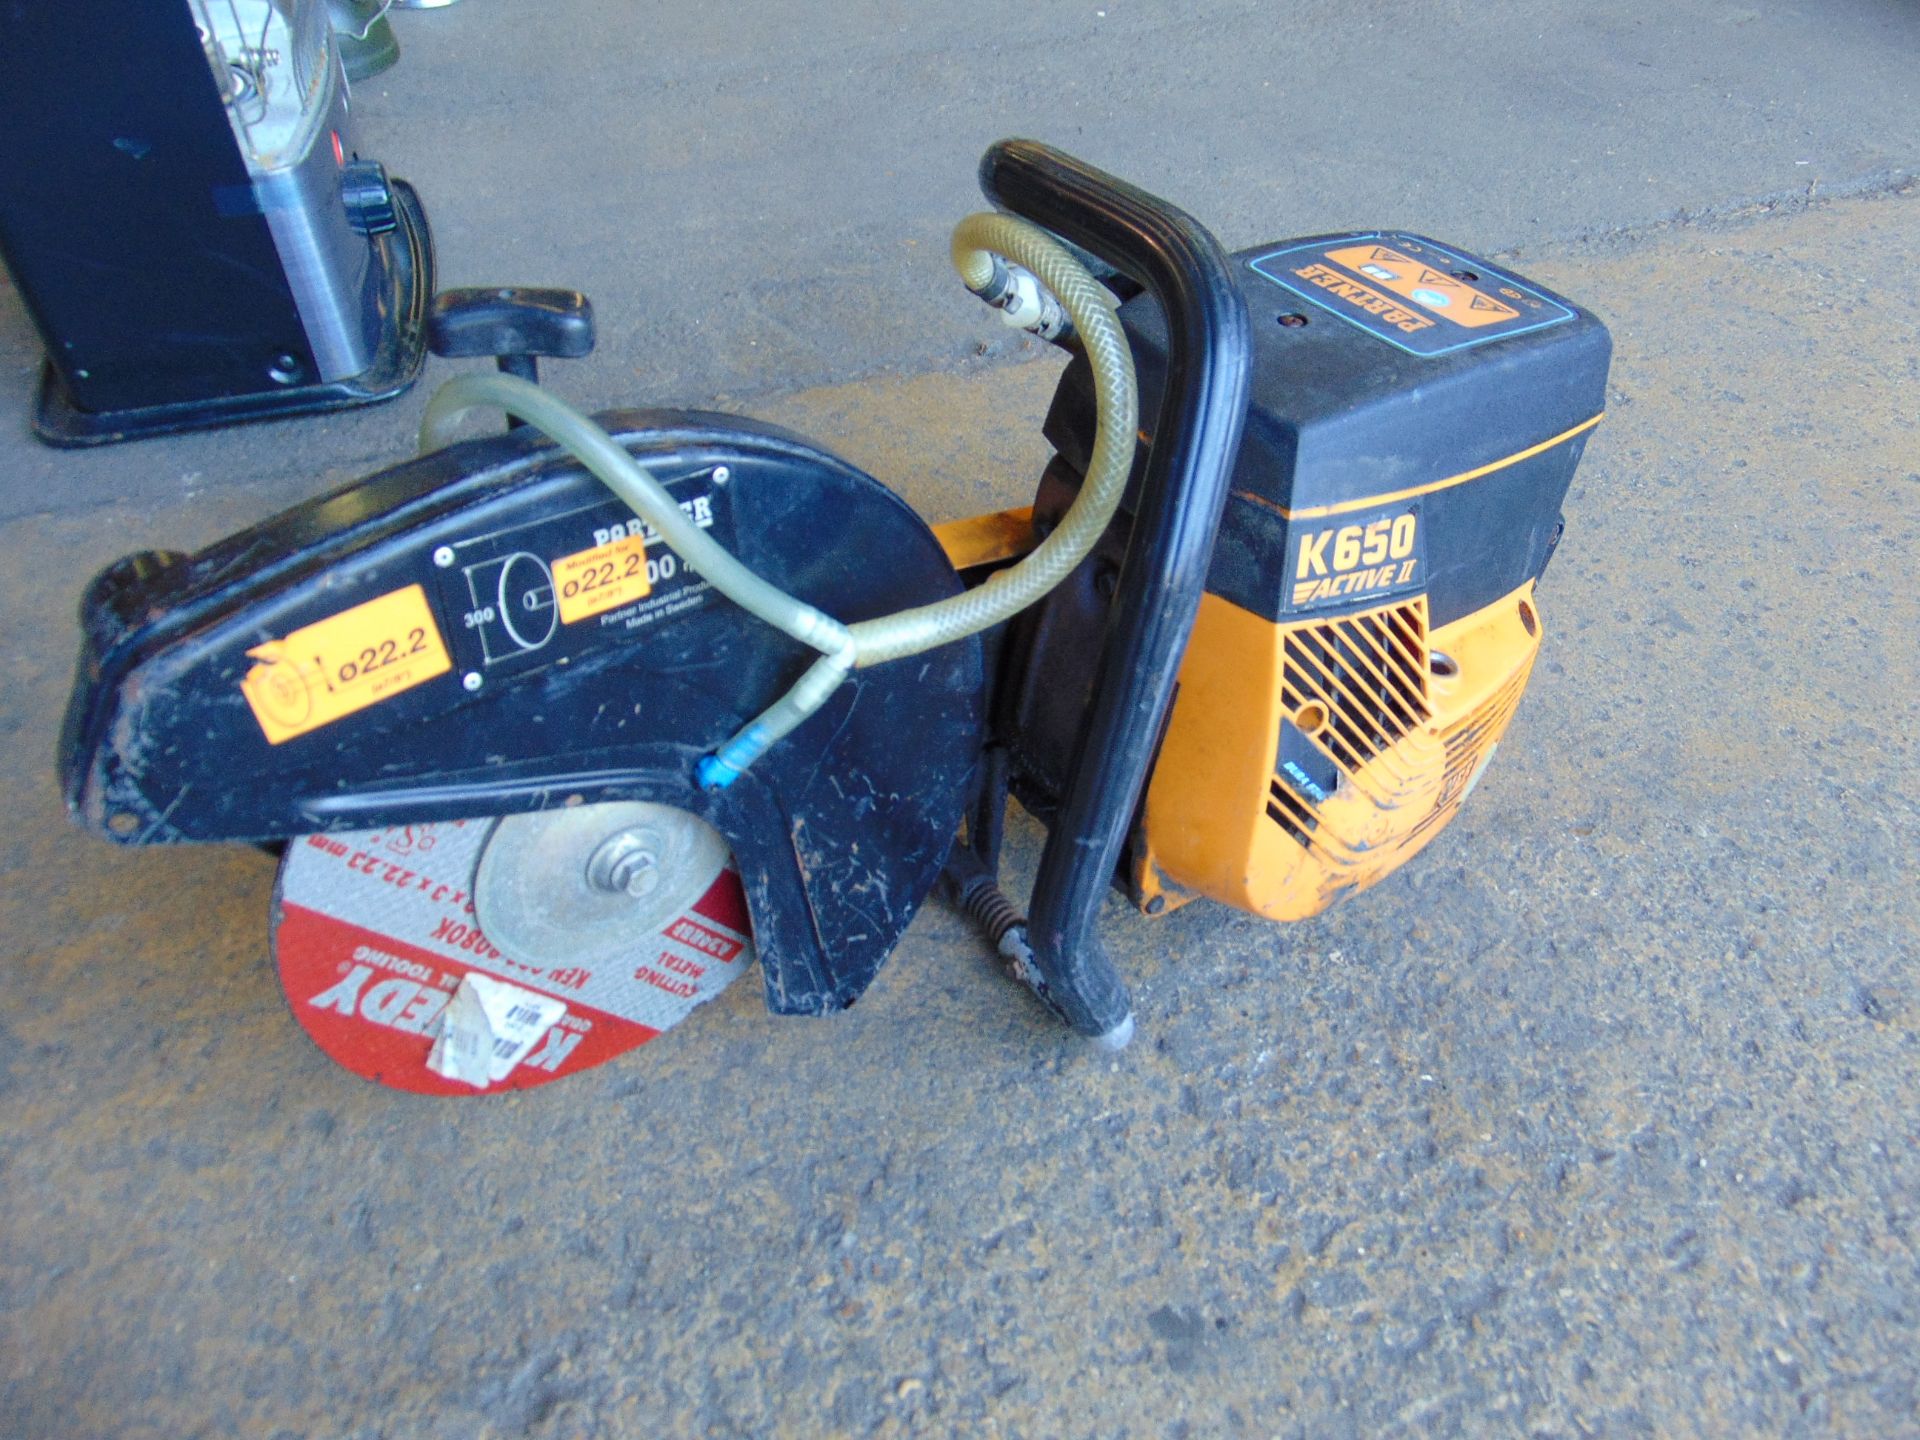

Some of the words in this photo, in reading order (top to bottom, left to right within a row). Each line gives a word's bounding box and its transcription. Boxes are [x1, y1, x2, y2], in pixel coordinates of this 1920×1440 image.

[1295, 265, 1427, 333] PARTNER
[593, 496, 713, 546] PARER
[1296, 513, 1416, 579] K650
[647, 553, 676, 585] 00
[1310, 566, 1395, 602] ACTIVE
[463, 607, 495, 629] 300
[626, 614, 654, 630] Made
[666, 595, 705, 614] Sweden
[347, 850, 415, 889] 22.23
[417, 878, 433, 891] x
[353, 944, 433, 981] TOOLING
[309, 964, 583, 1073] KEDY
